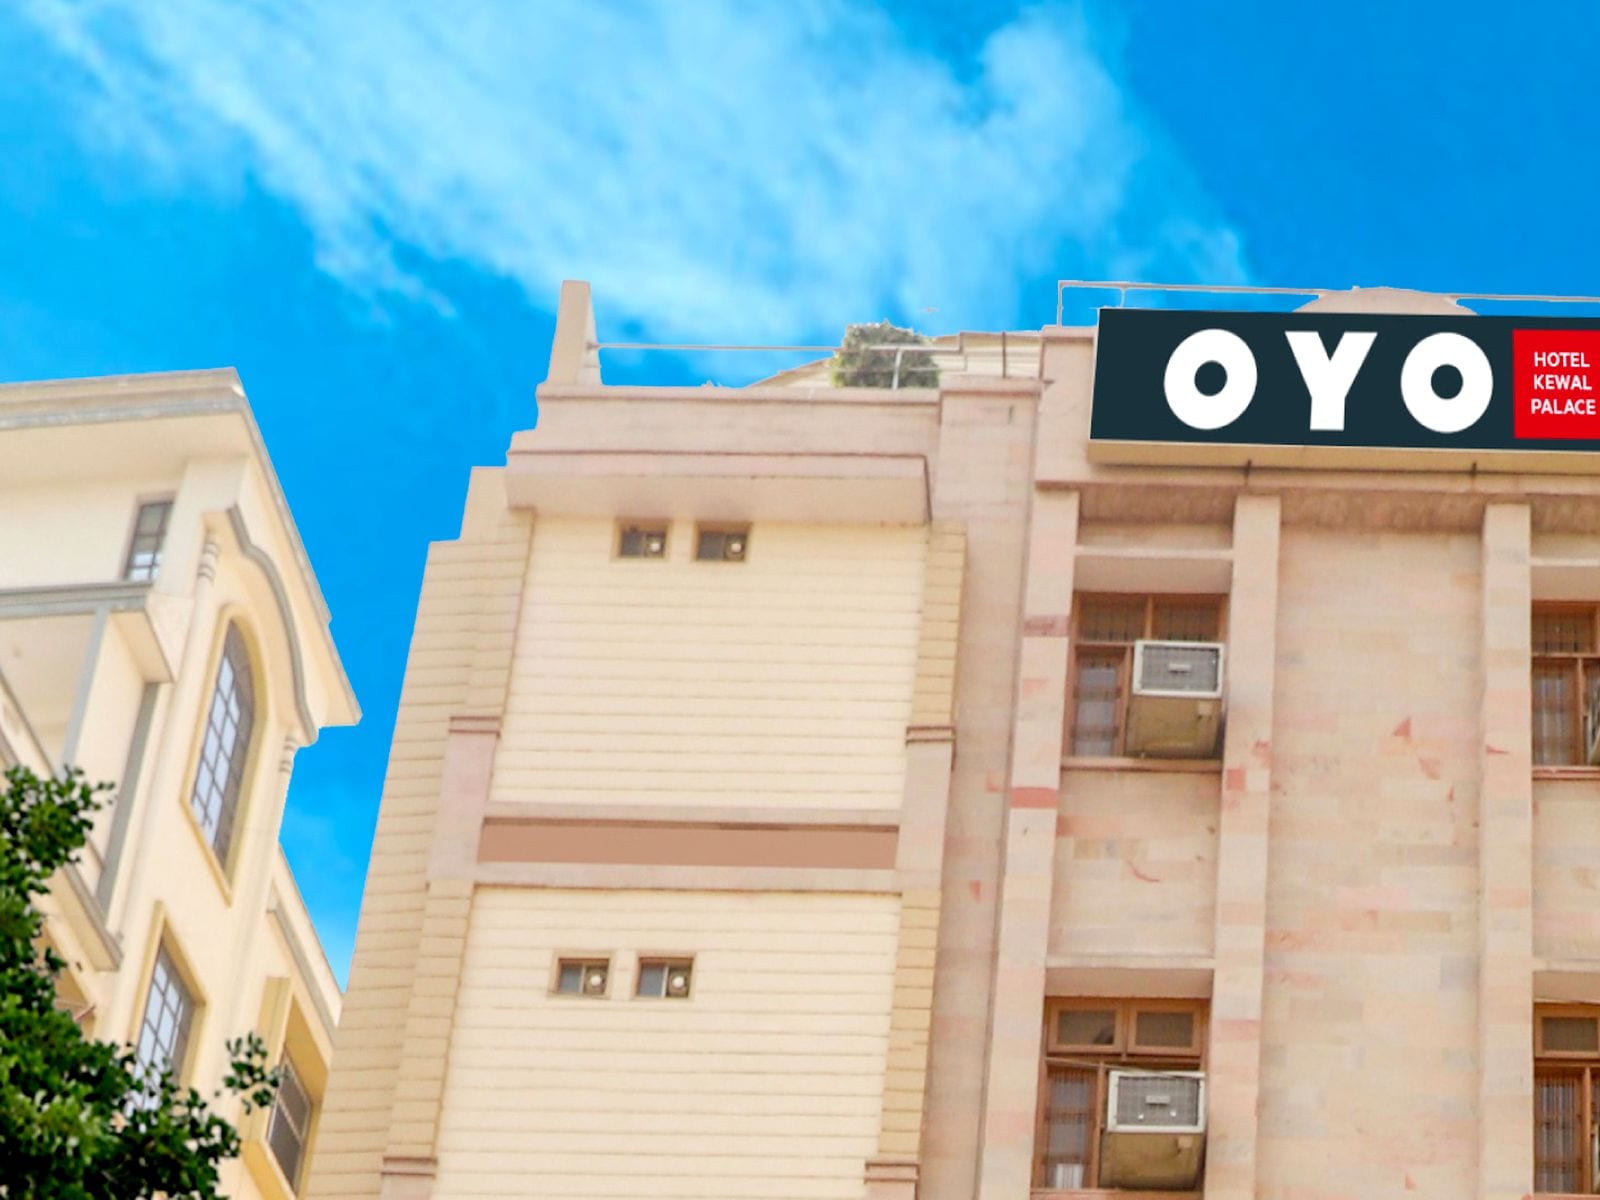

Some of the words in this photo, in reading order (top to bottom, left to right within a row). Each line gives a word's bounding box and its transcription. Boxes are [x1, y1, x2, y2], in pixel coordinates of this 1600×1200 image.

[1533, 351, 1591, 367] HOTEL
[1164, 328, 1493, 434] OYO
[1533, 374, 1593, 390] KEWAL
[1530, 398, 1596, 415] PALACE
